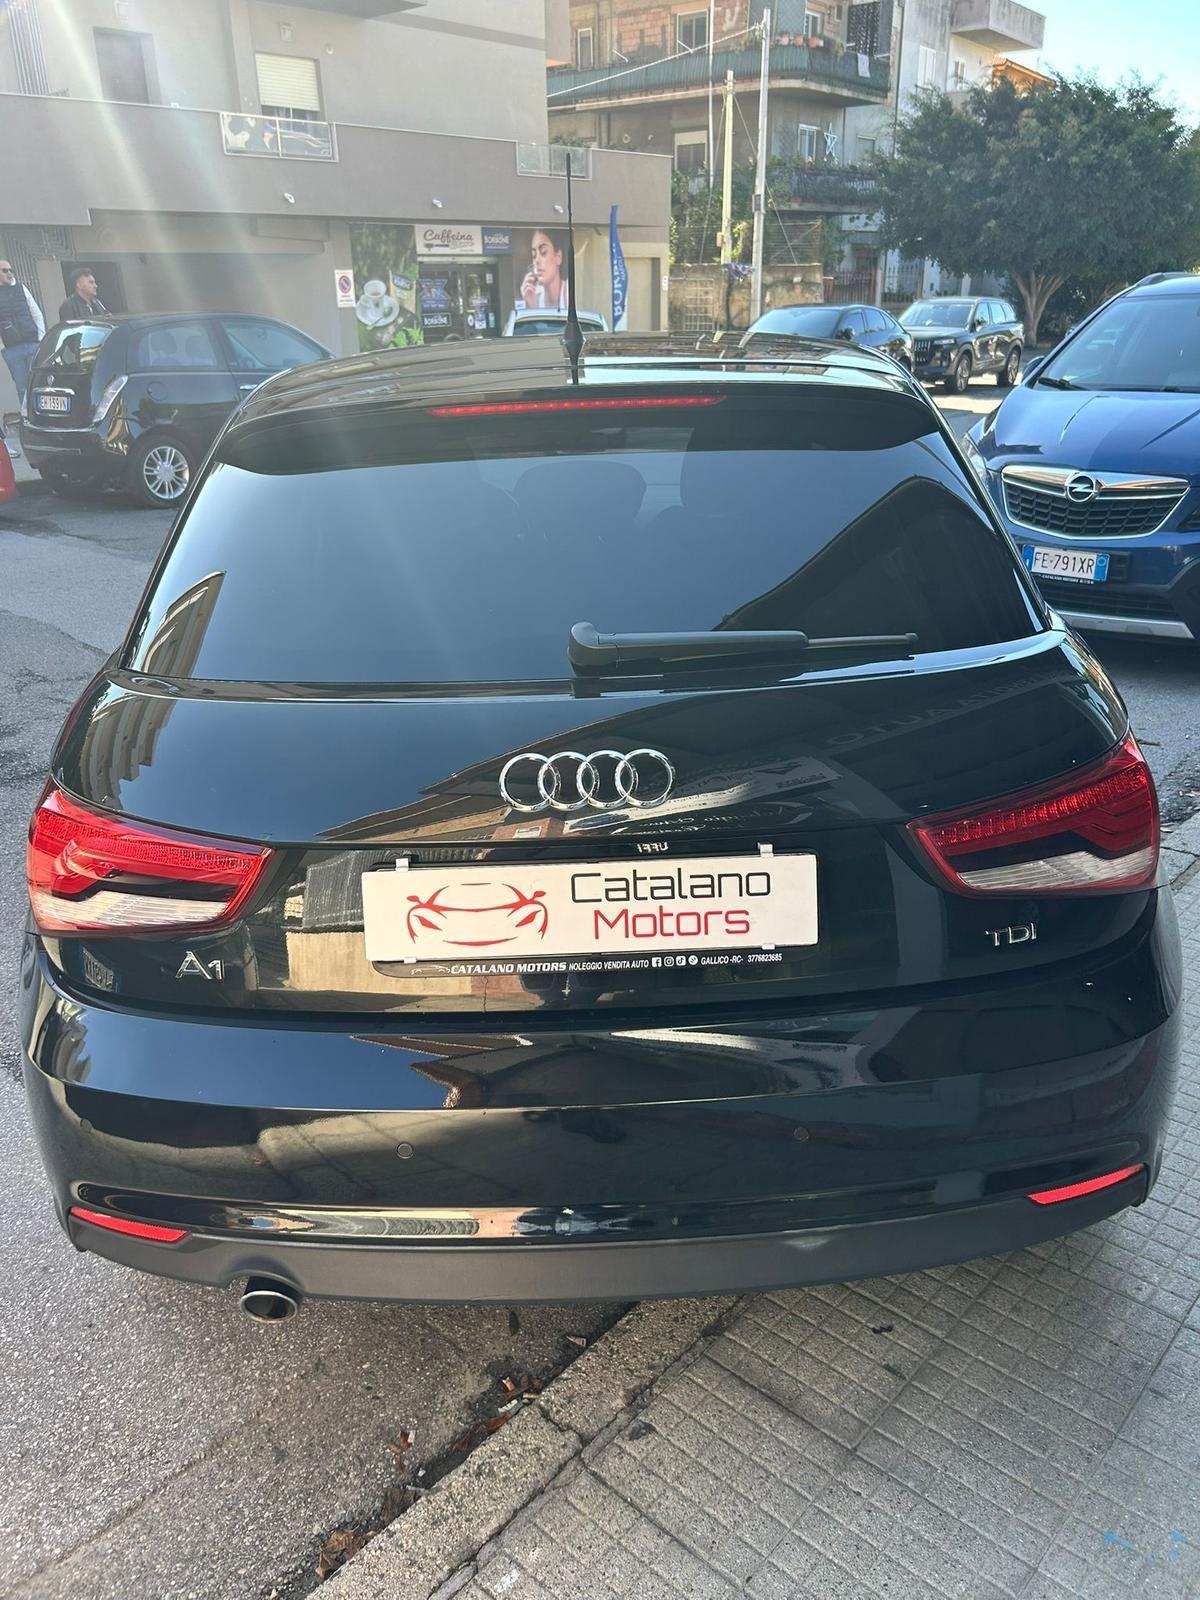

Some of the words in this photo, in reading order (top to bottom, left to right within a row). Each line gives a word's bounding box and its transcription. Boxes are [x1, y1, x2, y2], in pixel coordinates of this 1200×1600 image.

[423, 229, 474, 244] Caffeina
[570, 867, 771, 903] Catalano
[594, 905, 750, 940] Motors
[985, 922, 1037, 947] TDI
[175, 950, 225, 981] A1
[451, 963, 514, 974] CATALANO
[516, 962, 567, 973] MOTORS
[568, 961, 602, 971] NOLEGGIO
[603, 960, 630, 969] VENDITA
[631, 959, 649, 968] AUTO
[701, 955, 729, 965] GALLICO
